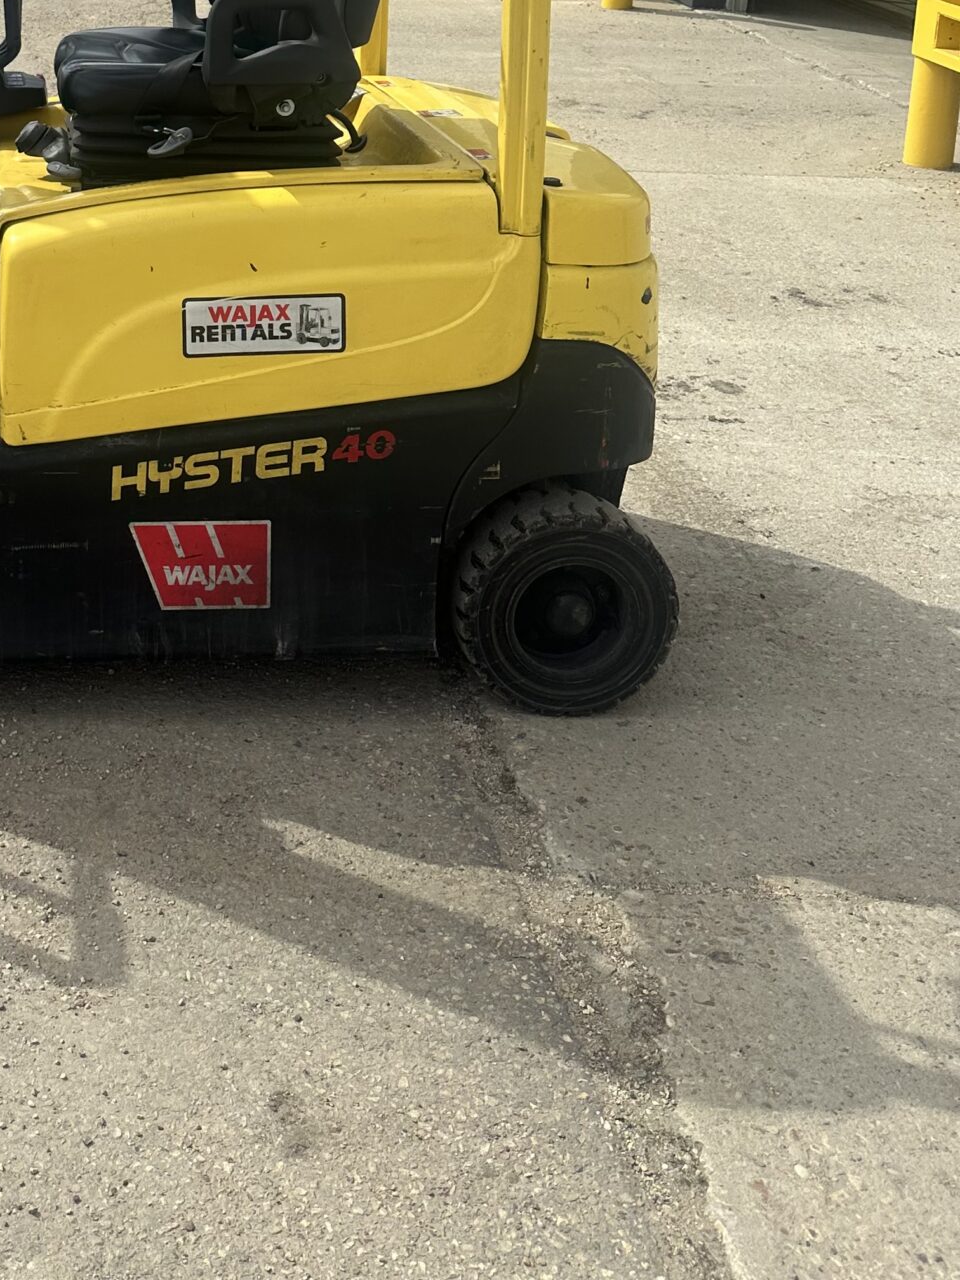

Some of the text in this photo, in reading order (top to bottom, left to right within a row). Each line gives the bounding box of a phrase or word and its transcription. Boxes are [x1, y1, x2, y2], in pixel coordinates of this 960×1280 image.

[208, 304, 292, 328] WAJAX
[191, 323, 293, 343] RENTALS
[111, 430, 397, 502] HYSTER 40
[163, 564, 254, 591] WAJAX
